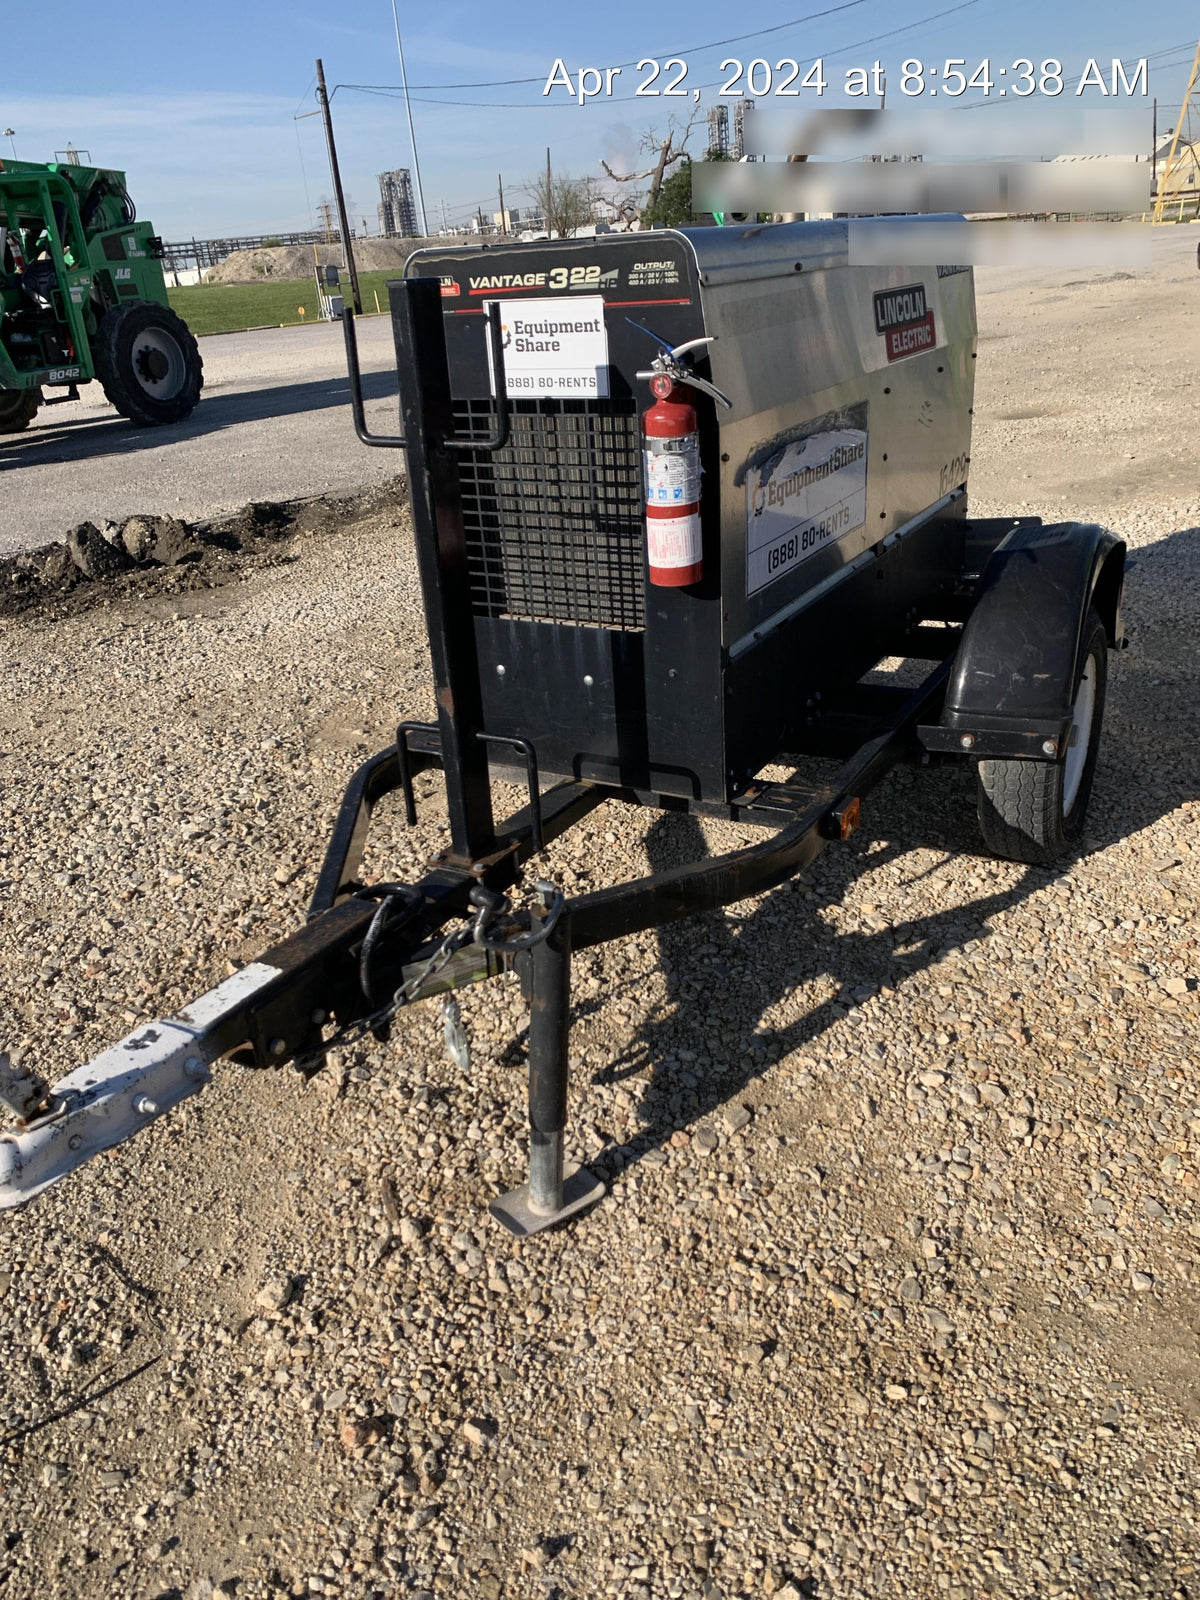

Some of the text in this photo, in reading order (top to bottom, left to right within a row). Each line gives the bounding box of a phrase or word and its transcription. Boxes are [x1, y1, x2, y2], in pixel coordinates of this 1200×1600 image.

[115, 268, 131, 280] JLG
[633, 261, 673, 270] OUTPUT
[469, 272, 546, 289] VANTAGE
[549, 265, 601, 289] 322
[876, 291, 925, 326] LINCOLN
[513, 319, 601, 337] Equipment
[515, 337, 561, 353] Share
[892, 326, 932, 354] ELECTRIC
[50, 367, 80, 381] 8042
[507, 376, 597, 389] 888) 80-RENTS
[767, 506, 850, 574] (888) 80-RENTS
